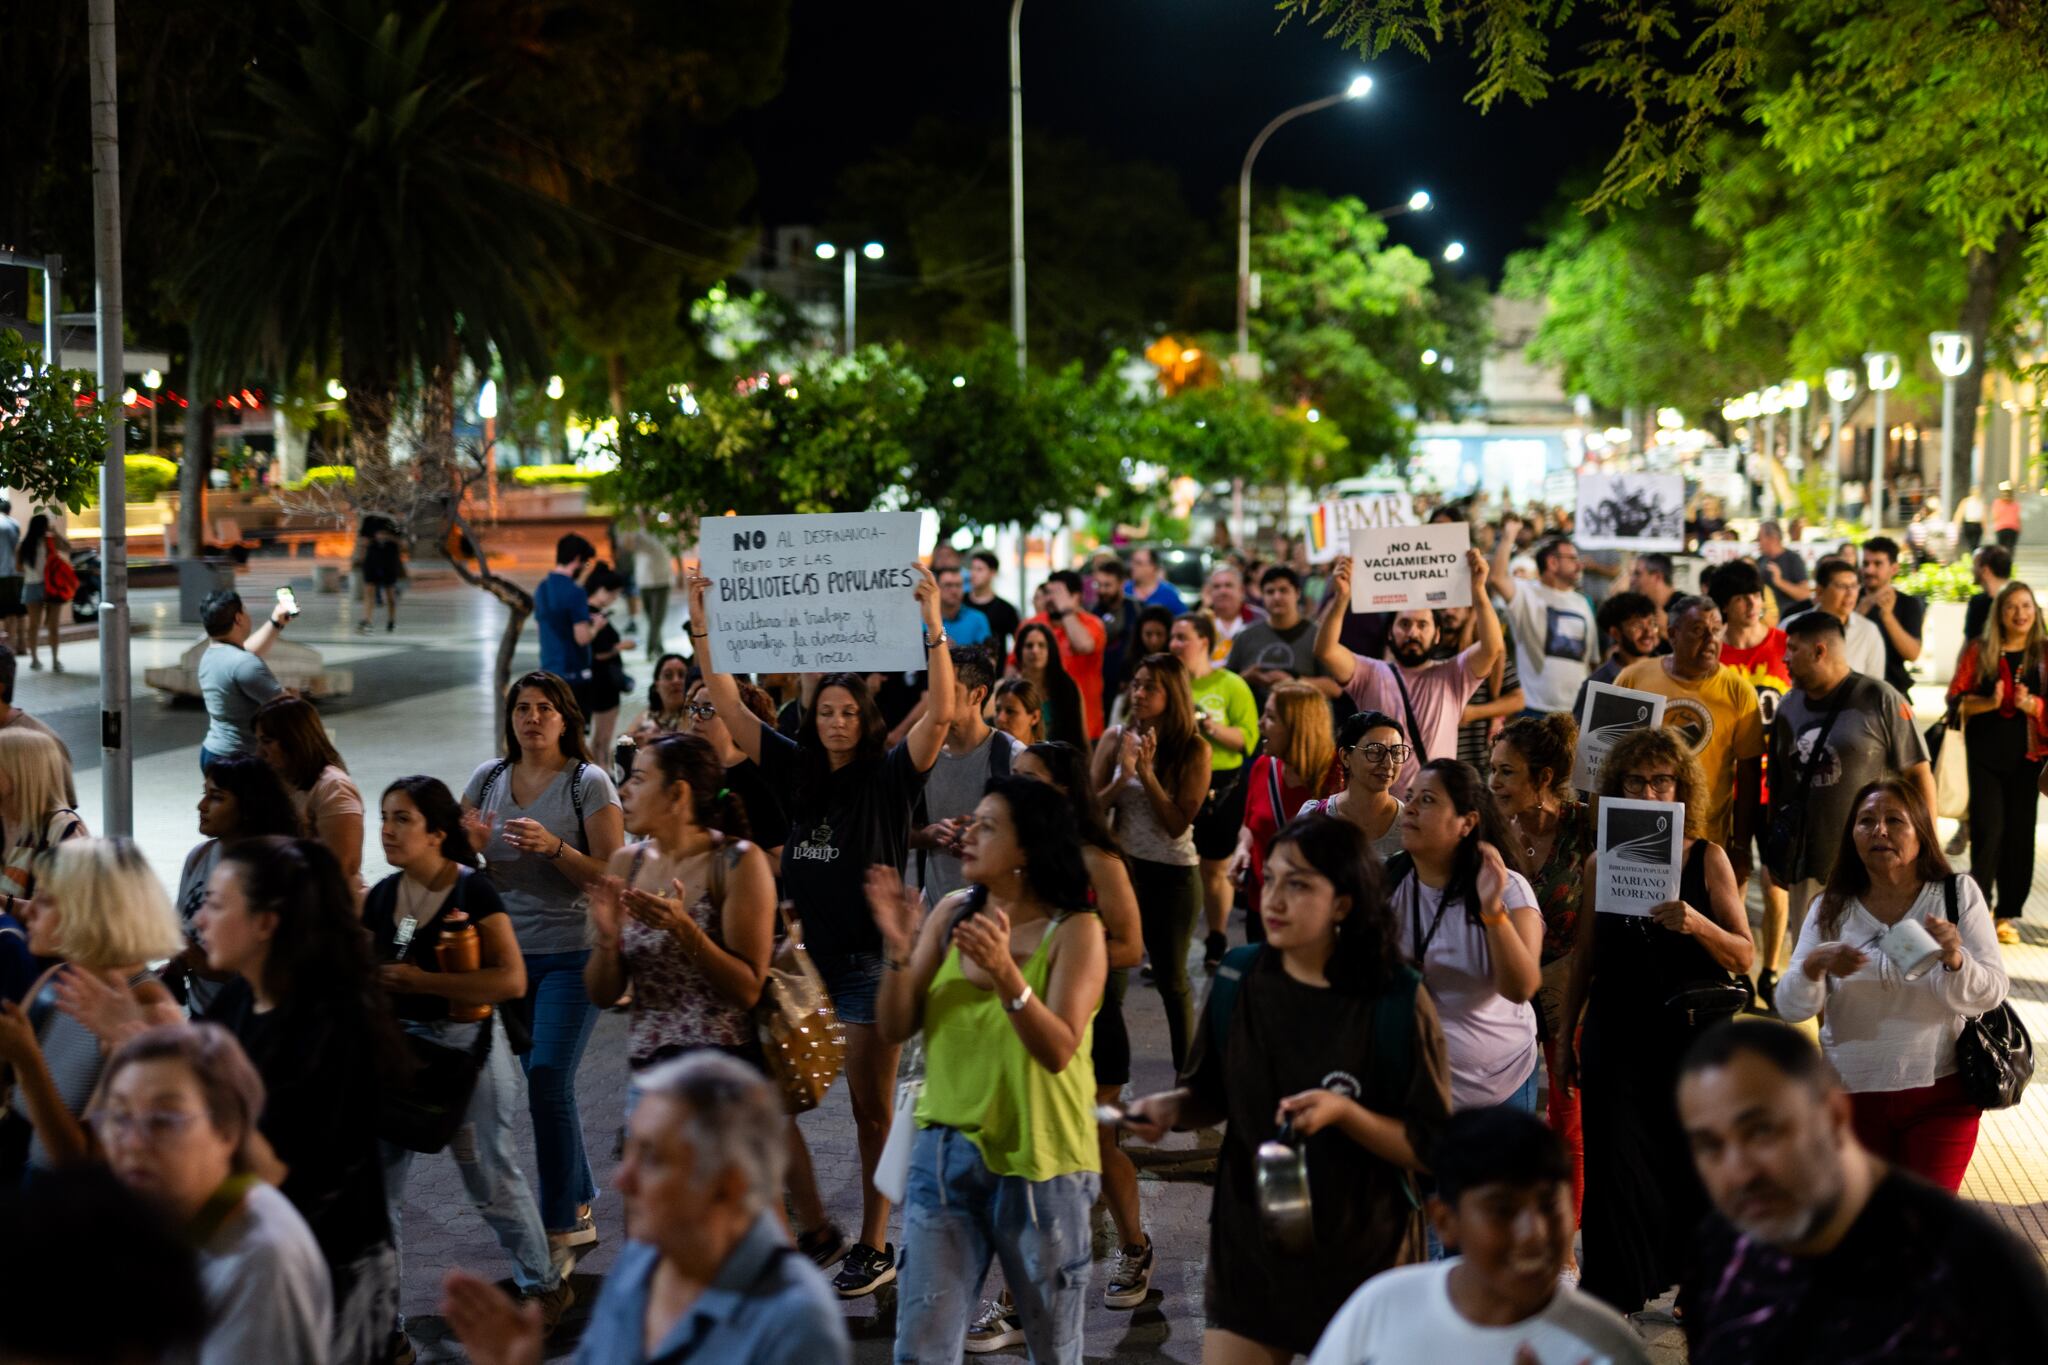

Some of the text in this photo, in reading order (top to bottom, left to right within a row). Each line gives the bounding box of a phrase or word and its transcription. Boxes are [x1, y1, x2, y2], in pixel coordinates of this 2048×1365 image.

[733, 530, 767, 551] NO
[776, 531, 795, 548] AL
[1387, 541, 1432, 555] ¡NO AL
[778, 556, 797, 568] DE
[803, 554, 833, 566] LAS
[1364, 554, 1457, 568] VACIAMIENTO
[1373, 568, 1449, 582] CULTURAL!
[720, 568, 913, 602] BIBLIOTECAS POPULARES
[1610, 874, 1667, 888] MARIANO
[1610, 886, 1667, 901] MORENO
